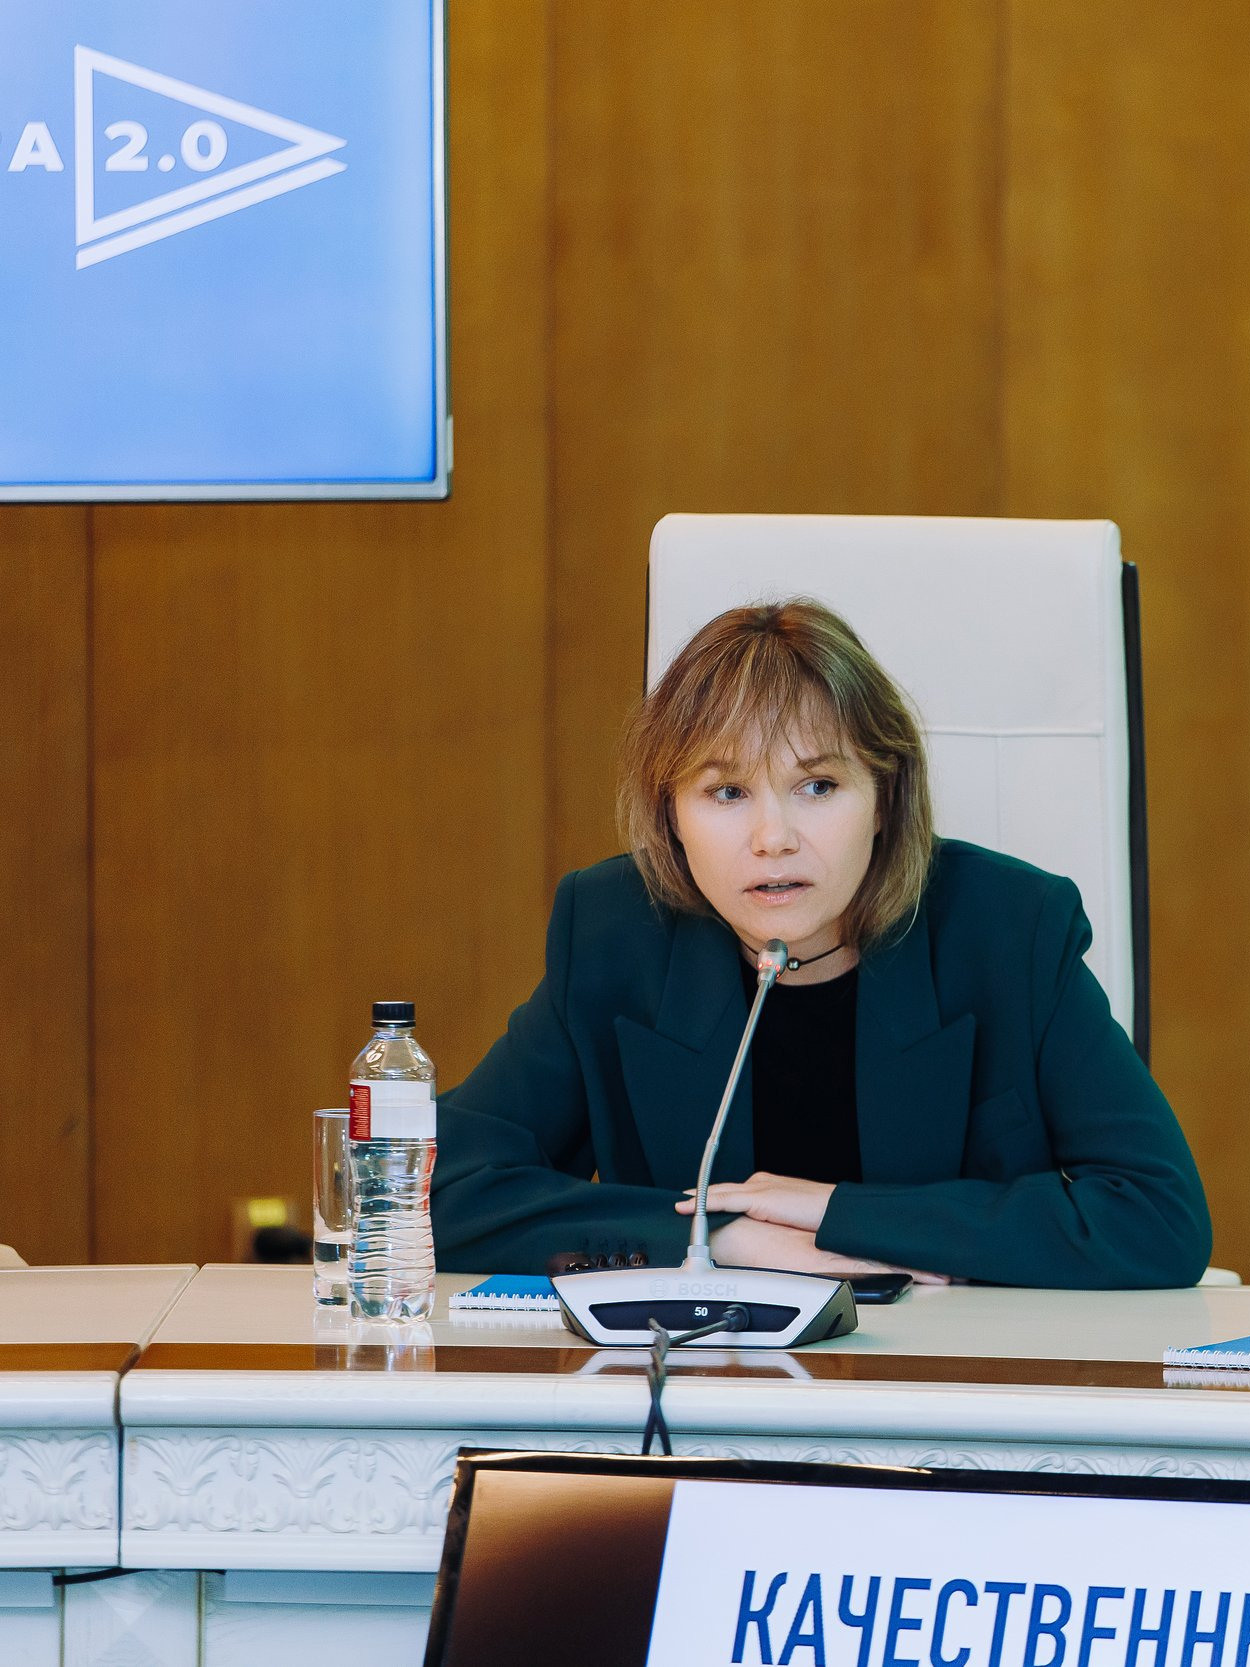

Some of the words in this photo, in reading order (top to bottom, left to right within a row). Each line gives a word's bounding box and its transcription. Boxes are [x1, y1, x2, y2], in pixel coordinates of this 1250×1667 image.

[104, 119, 229, 172] 2.0
[678, 1283, 738, 1297] BOSCH
[694, 1306, 709, 1317] 50
